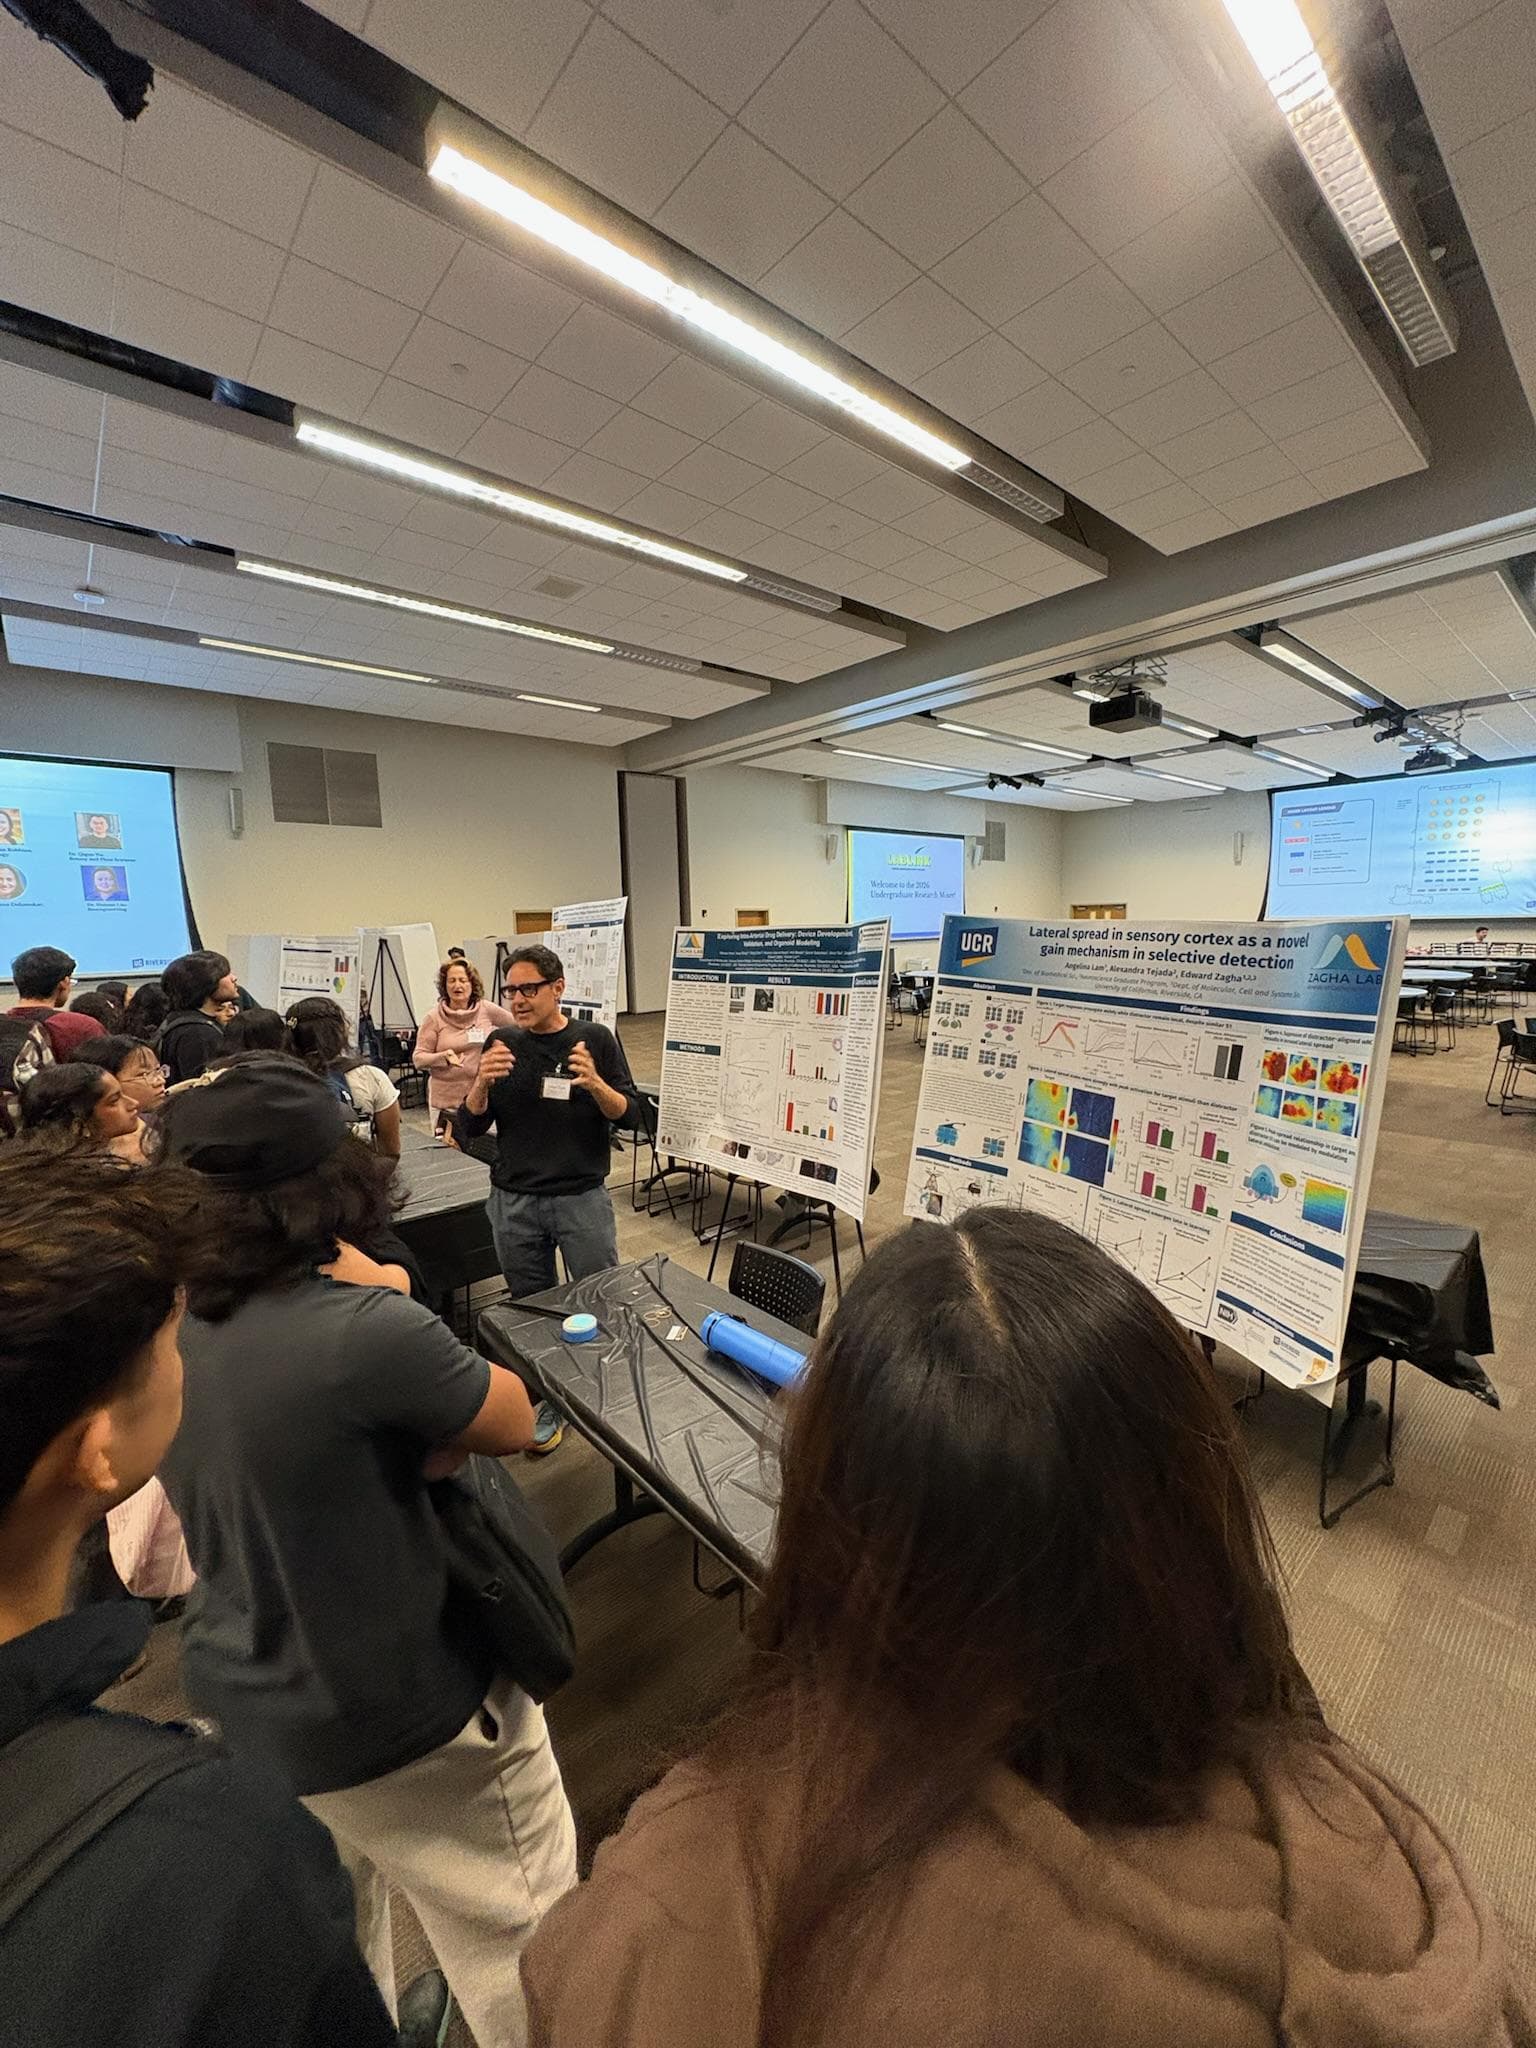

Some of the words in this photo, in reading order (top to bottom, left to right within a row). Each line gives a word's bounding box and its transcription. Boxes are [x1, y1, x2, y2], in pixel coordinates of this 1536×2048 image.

[870, 880, 898, 888] Welcome
[906, 880, 915, 888] the
[870, 890, 913, 900] Undergraduate
[717, 932, 740, 940] Exploring
[798, 930, 817, 938] Device
[1029, 926, 1069, 939] Lateral
[1072, 928, 1109, 942] spread
[1111, 928, 1123, 940] in
[1126, 930, 1180, 945] sensory
[1184, 932, 1233, 946] cortex
[1238, 935, 1257, 947] as
[1261, 937, 1272, 948] a
[1276, 932, 1310, 949] novel
[796, 940, 821, 948] Modeling
[961, 932, 993, 953] UCR
[1040, 943, 1064, 957] gain
[1067, 945, 1129, 959] mechanism
[1133, 946, 1145, 960] in
[1148, 948, 1215, 965] selective
[1220, 952, 1294, 970] detection
[678, 973, 720, 982] INTRODUCTION
[1065, 962, 1090, 971] Angelina
[1109, 965, 1145, 975] Alexandra
[1180, 970, 1213, 981] Edward
[767, 976, 791, 984] RESULTS
[1307, 972, 1350, 984] ZAGHA
[1356, 973, 1383, 985] LAB
[972, 982, 996, 991] Abstract
[1191, 983, 1201, 991] of
[1238, 986, 1253, 994] Cell
[1254, 988, 1270, 997] and
[1179, 1005, 1210, 1017] Findings
[1205, 1020, 1225, 1028] similar
[1313, 1042, 1334, 1050] spread
[1162, 1092, 1177, 1100] target
[1210, 1101, 1238, 1111] distractor
[1293, 1135, 1325, 1148] relationship
[1331, 1145, 1348, 1154] target
[1311, 1146, 1318, 1155] by
[1318, 1150, 1348, 1163] modulating
[1134, 1204, 1150, 1215] spread
[1189, 1222, 1210, 1235] learning
[1269, 1228, 1306, 1251] Conclusions
